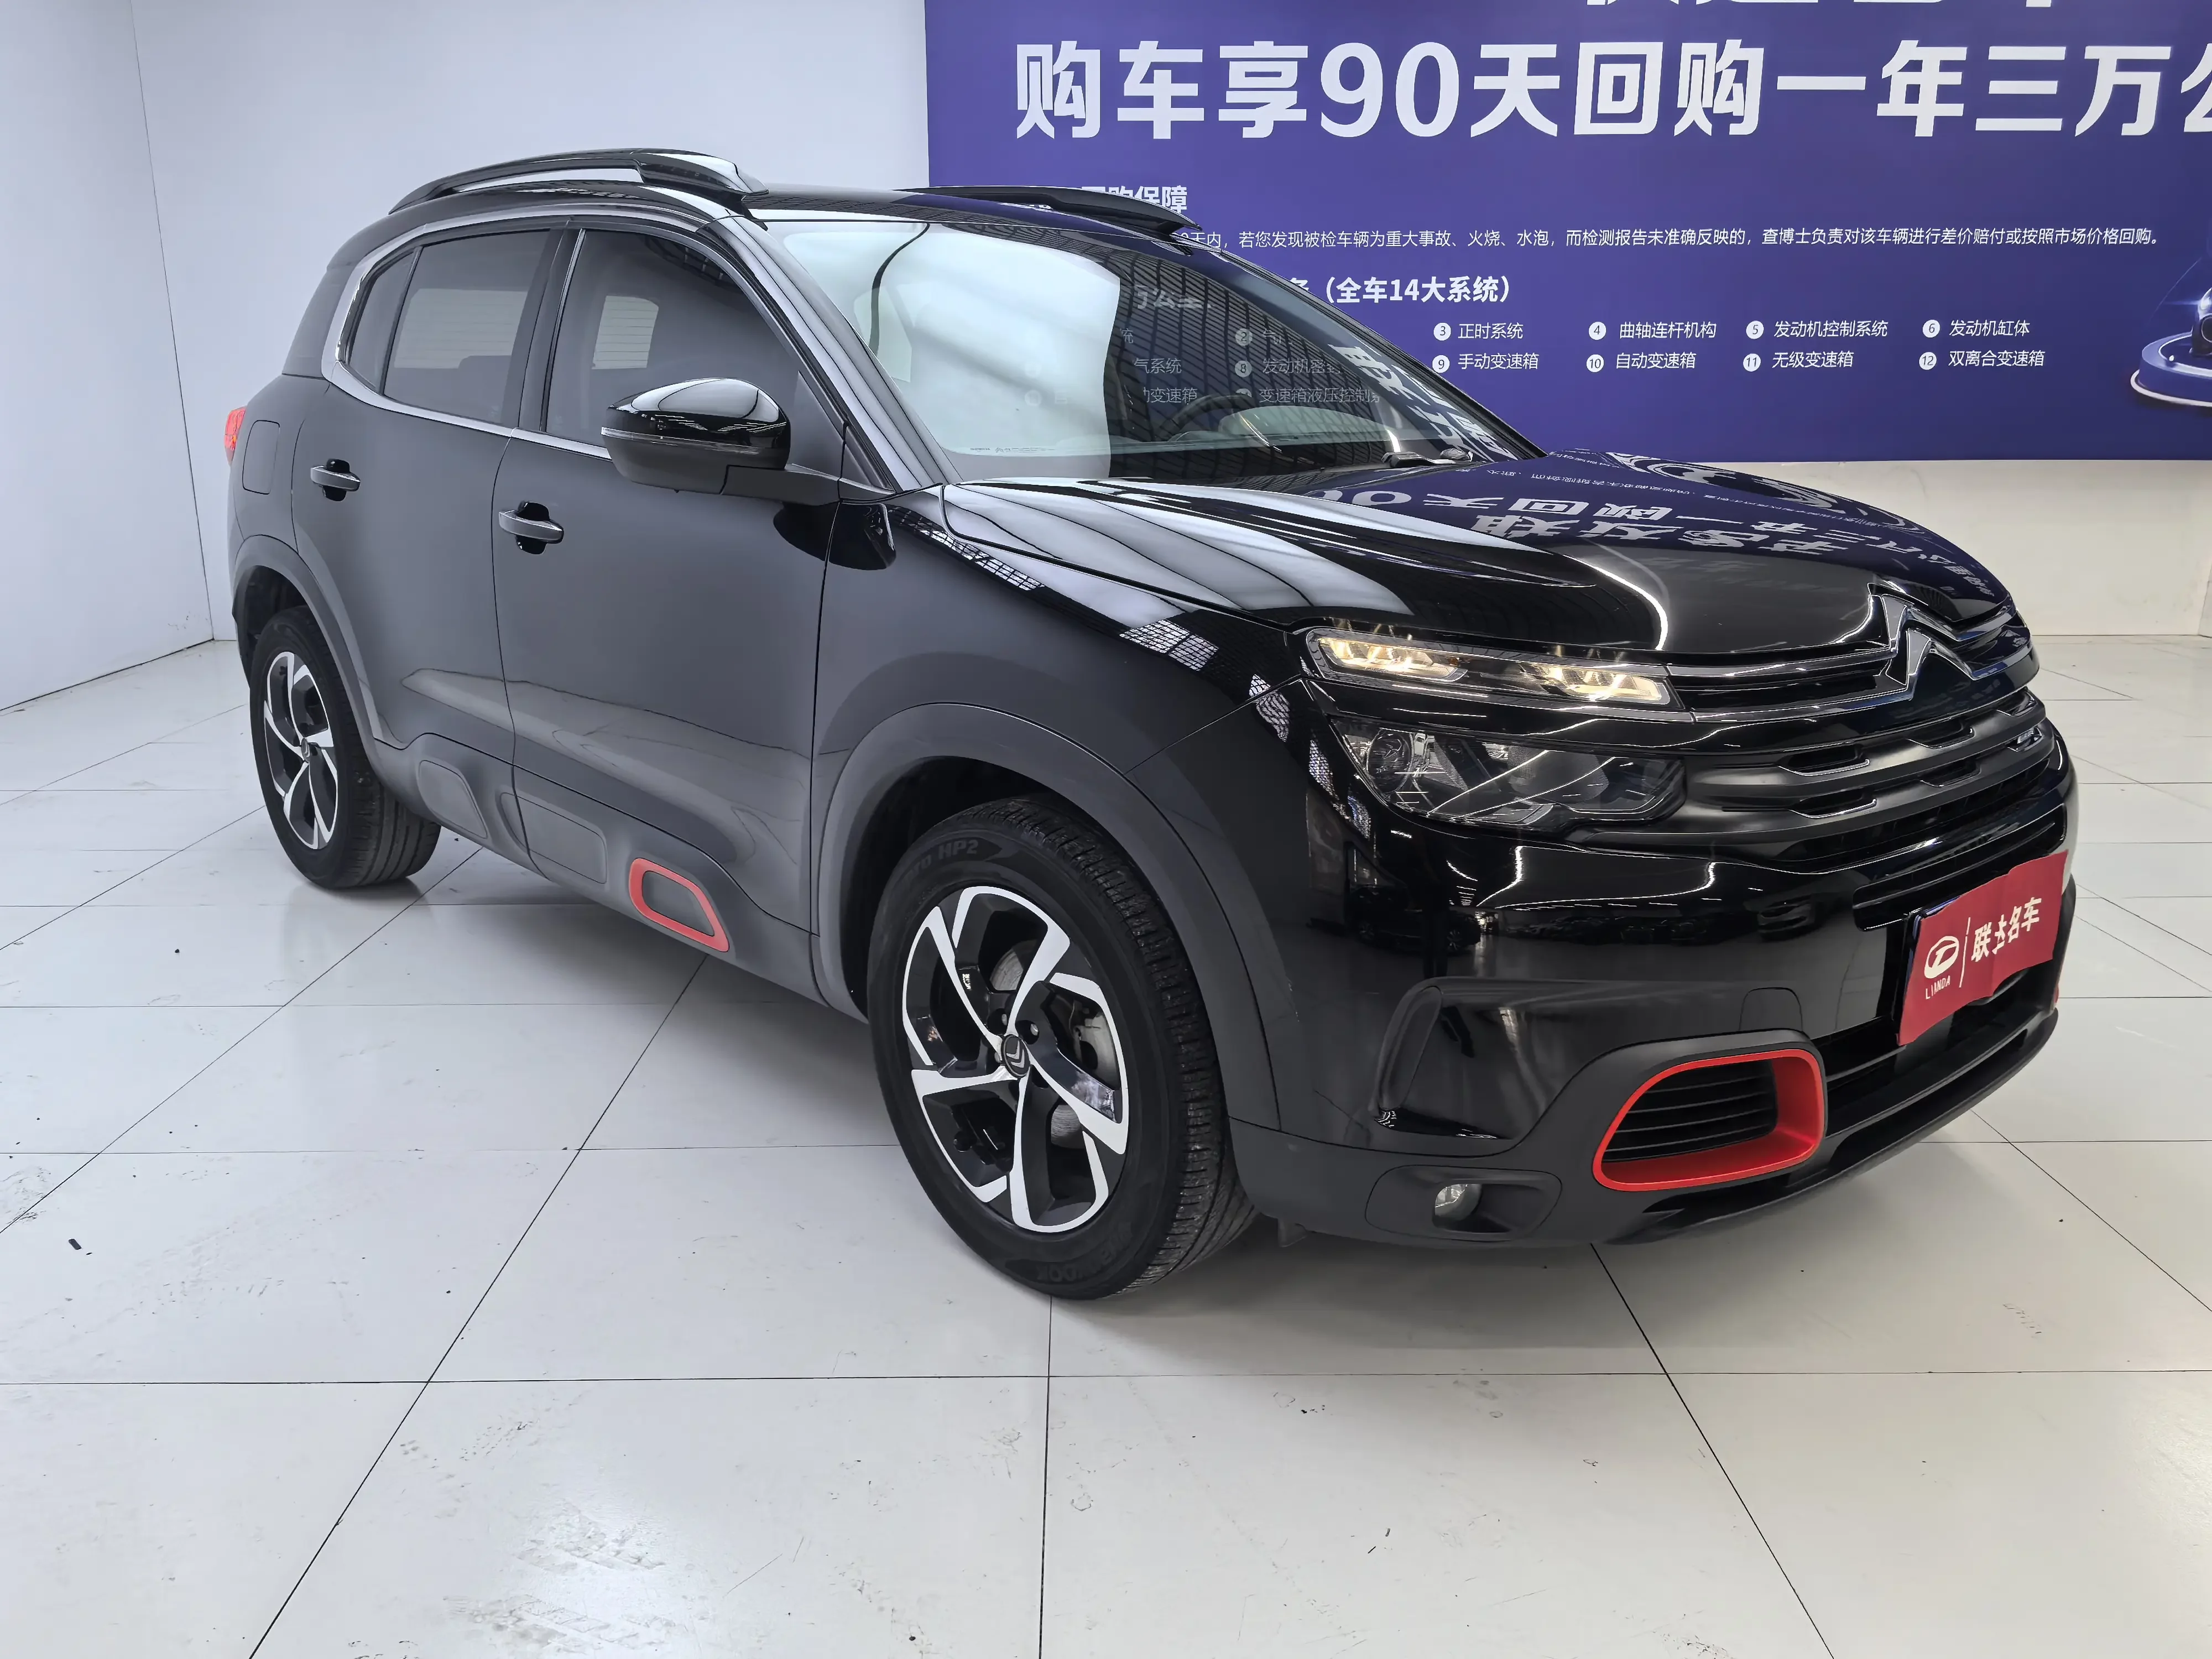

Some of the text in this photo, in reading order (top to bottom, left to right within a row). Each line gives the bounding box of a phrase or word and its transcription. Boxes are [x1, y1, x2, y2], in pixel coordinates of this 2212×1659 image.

[1457, 322, 1524, 339] 正时系统
[1619, 321, 1717, 339] 曲轴连杆机构
[1773, 320, 1889, 338] 发动机控制系统
[1949, 319, 2031, 337] 发动机缸体
[1458, 352, 1540, 370] 手动变速箱
[1616, 351, 1697, 369] 自动变速箱
[1772, 350, 1854, 368] 无级变速箱
[1948, 349, 2046, 367] 双离合变速箱
[1970, 896, 2042, 962] 联达名车
[1925, 975, 1950, 999] LIANDA
